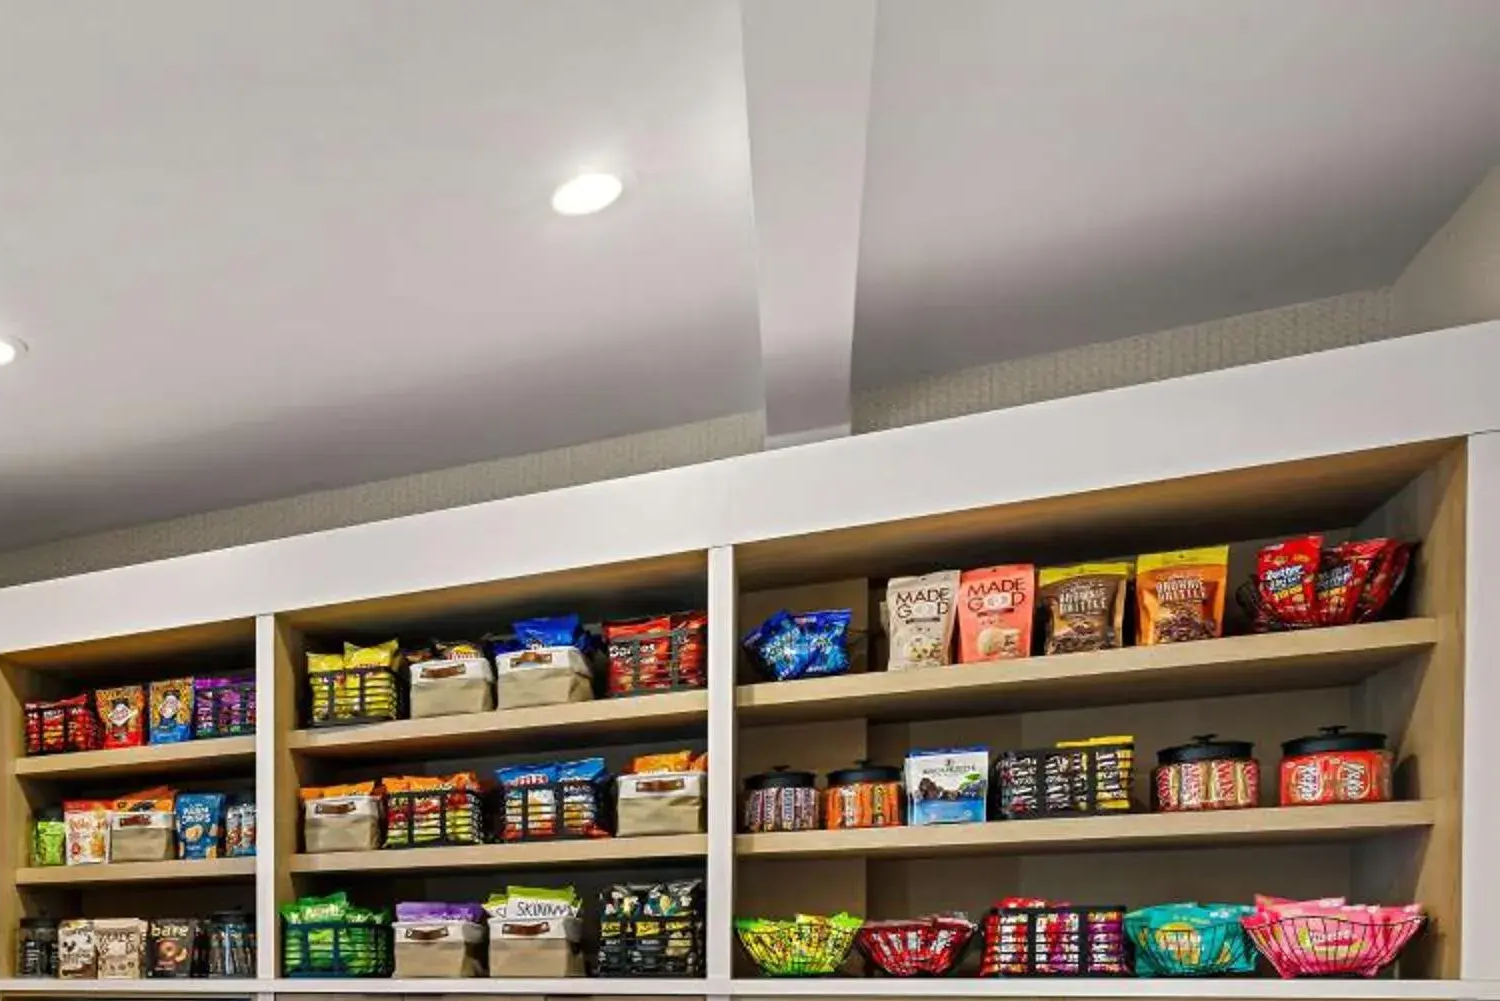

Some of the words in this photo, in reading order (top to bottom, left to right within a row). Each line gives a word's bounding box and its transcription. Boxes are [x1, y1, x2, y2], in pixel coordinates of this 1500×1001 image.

[895, 587, 949, 605] MADE
[967, 577, 1027, 597] MADE
[150, 922, 190, 937] bare
